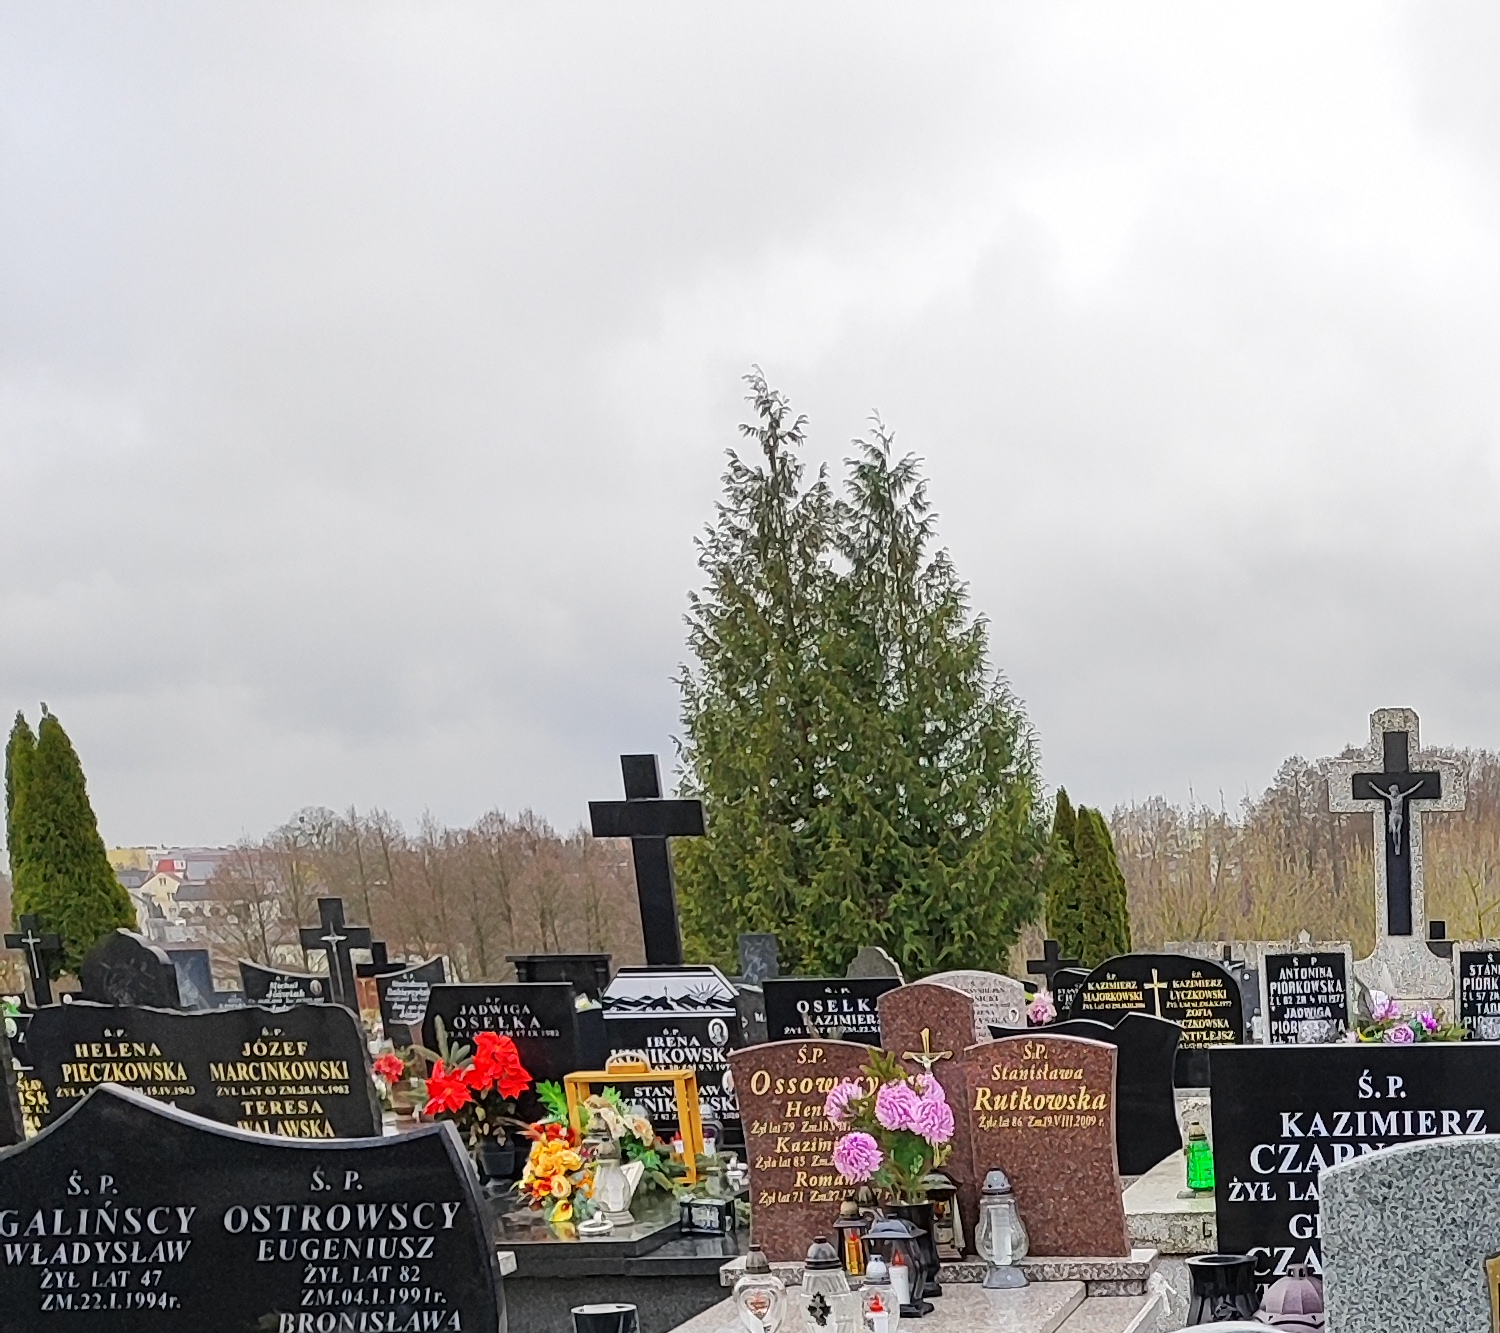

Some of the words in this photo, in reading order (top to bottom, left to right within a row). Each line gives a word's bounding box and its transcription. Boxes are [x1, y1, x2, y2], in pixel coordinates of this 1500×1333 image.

[1279, 966, 1333, 980] ANTONINA
[459, 1003, 531, 1015] JADWIGA
[1283, 1006, 1332, 1019] JADWIGA
[453, 1015, 541, 1030] OSEŁKA
[75, 1042, 162, 1058] HELENA
[242, 1038, 309, 1057] JÓZEF
[647, 1036, 701, 1047] IRENA
[61, 1061, 188, 1083] PIECZKOWSKA
[209, 1060, 350, 1082] MARCINKOWSKI
[991, 1062, 1084, 1081] Stanisława
[240, 1100, 324, 1116] TERESA
[972, 1085, 1108, 1111] Rutkowska
[1279, 1109, 1488, 1138] KAZIMIERZ
[1228, 1176, 1277, 1201] ŻYŁ
[0, 1200, 198, 1238] GALIŃSCY
[223, 1201, 462, 1234] OSTROWSCY
[3, 1240, 193, 1266] WŁADYSŁAW
[256, 1236, 435, 1262] EUGENIUSZ
[40, 1267, 81, 1289] ŻYŁ
[91, 1270, 131, 1288] LAT
[140, 1269, 163, 1287] 47
[303, 1263, 344, 1285] ŻYŁ
[352, 1266, 392, 1284] LAT
[399, 1265, 421, 1283] 82
